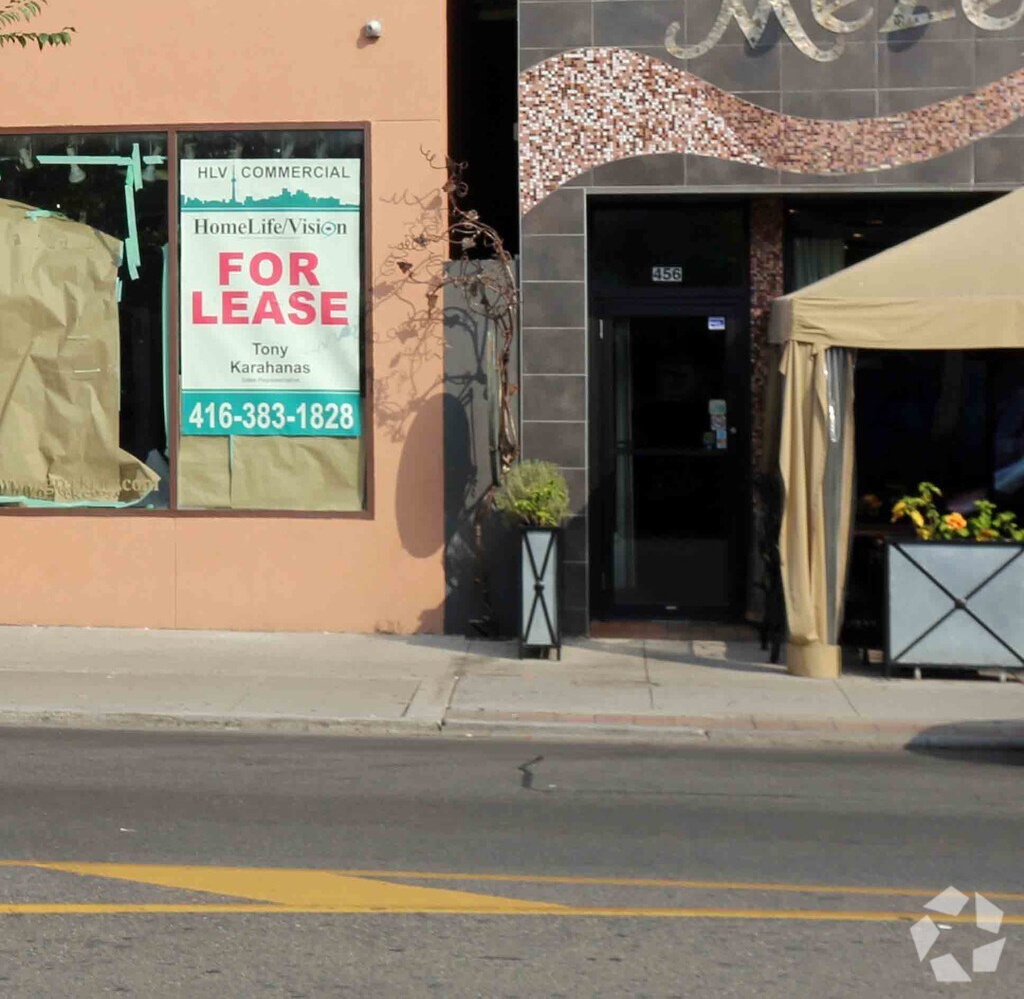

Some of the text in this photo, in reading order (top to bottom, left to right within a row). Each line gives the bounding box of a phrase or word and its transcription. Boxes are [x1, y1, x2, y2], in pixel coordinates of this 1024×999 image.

[198, 166, 350, 179] HLV COMMERCIAL
[218, 251, 320, 287] FOR
[653, 267, 682, 282] 456
[191, 290, 349, 325] LEASE
[252, 343, 288, 357] Tony
[230, 361, 311, 374] Karahanas
[188, 402, 354, 429] 416-383-1828
